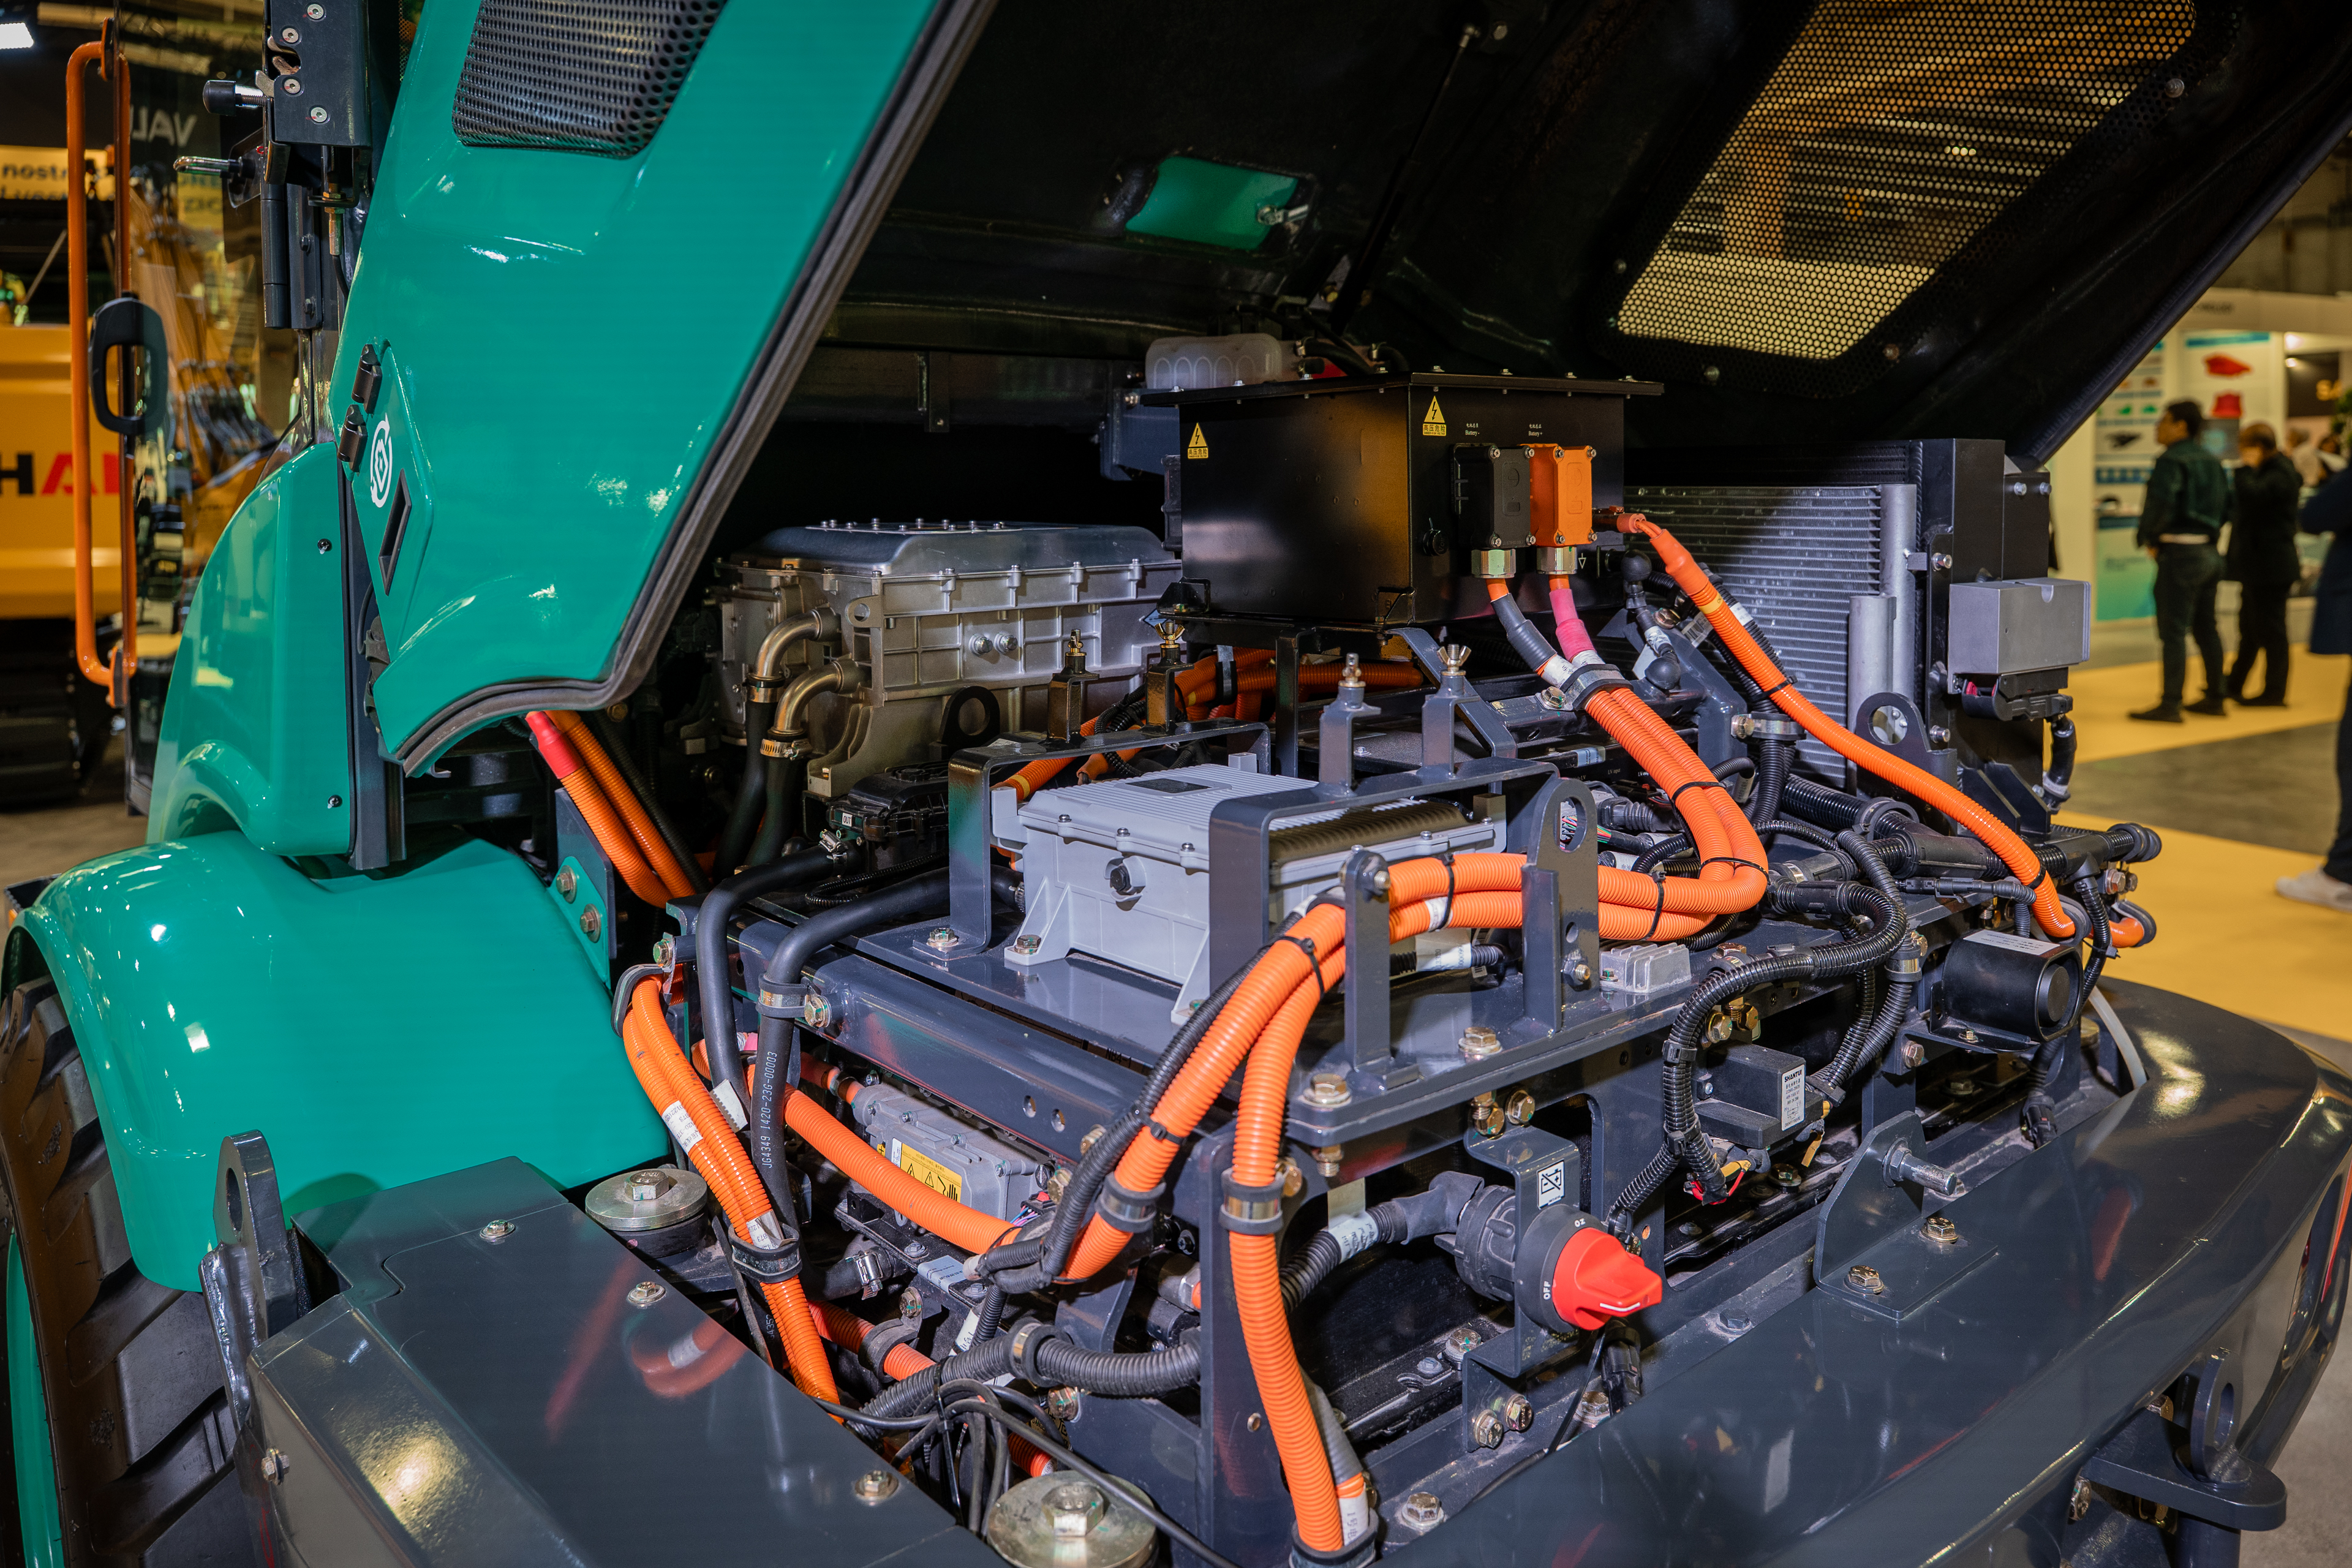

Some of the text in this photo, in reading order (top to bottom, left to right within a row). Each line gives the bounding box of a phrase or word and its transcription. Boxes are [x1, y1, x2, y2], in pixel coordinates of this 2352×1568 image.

[843, 815, 851, 824] OUT
[1784, 1069, 1803, 1083] SHANTUI
[761, 1050, 777, 1169] JG4349 1420-23G-00003
[1574, 1218, 1586, 1227] ON
[1543, 1281, 1551, 1300] OFF
